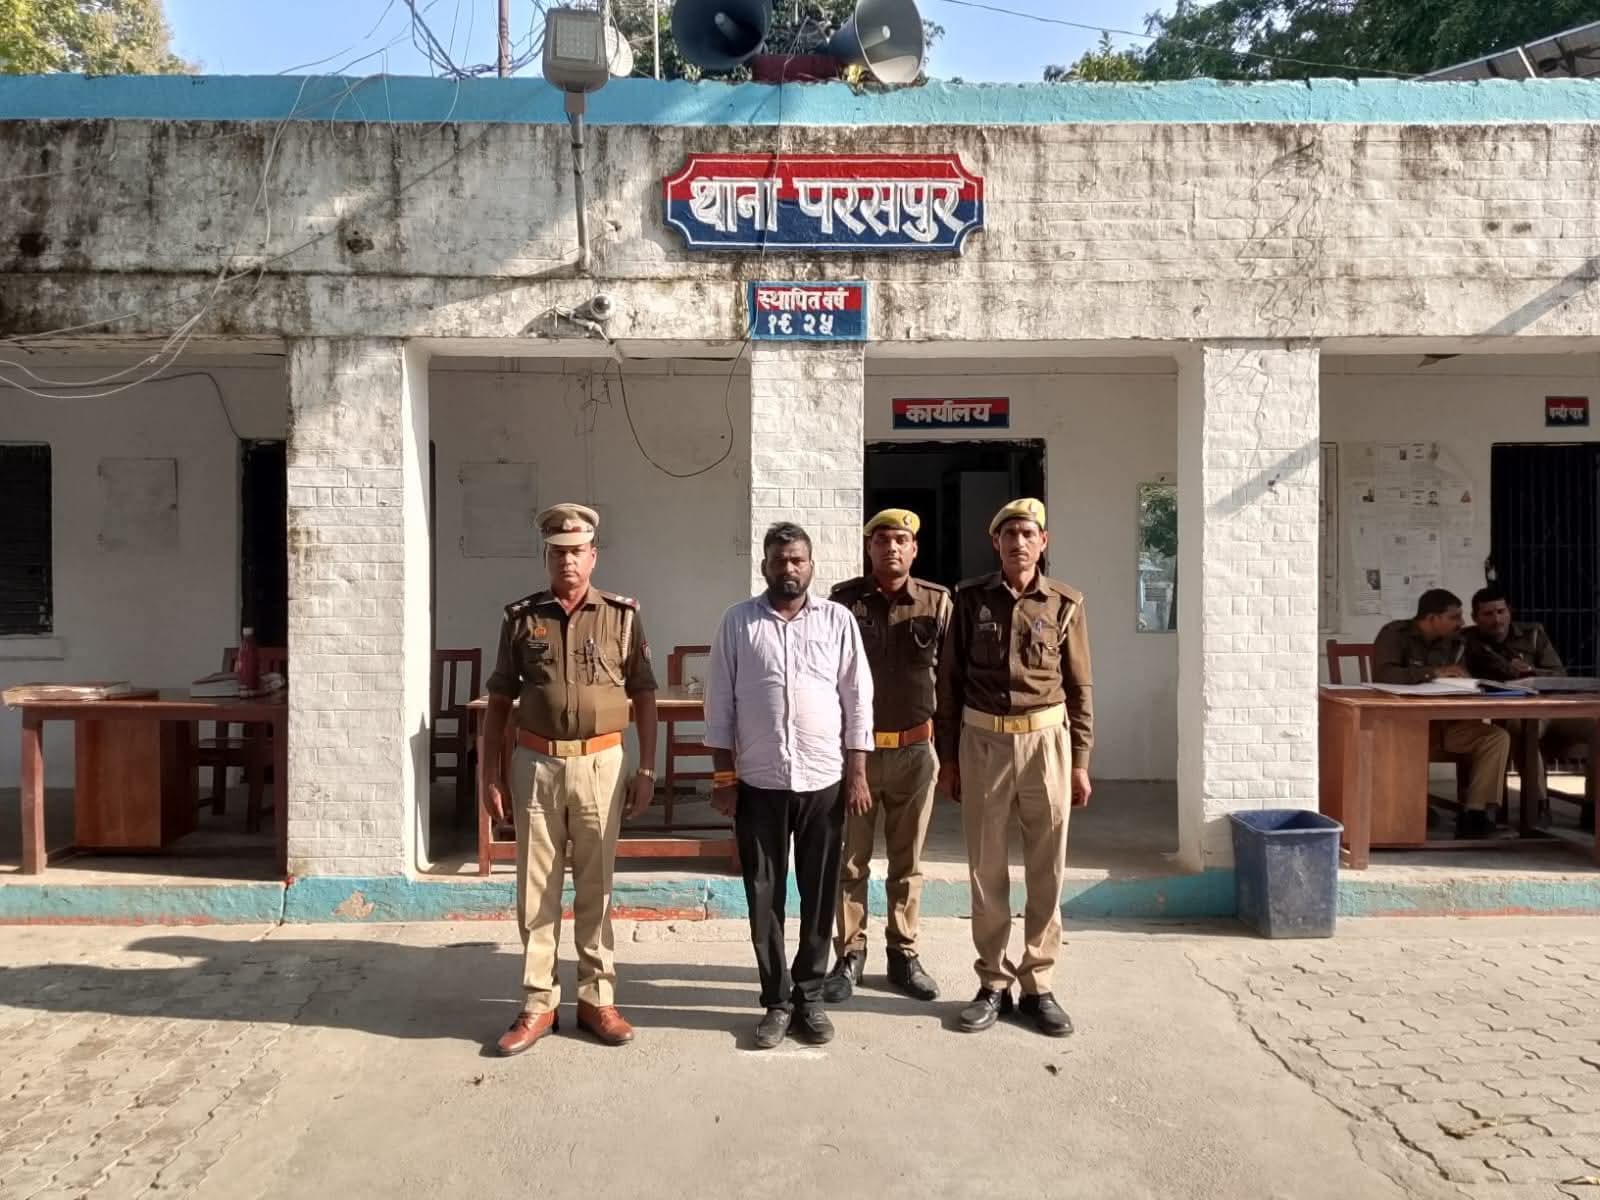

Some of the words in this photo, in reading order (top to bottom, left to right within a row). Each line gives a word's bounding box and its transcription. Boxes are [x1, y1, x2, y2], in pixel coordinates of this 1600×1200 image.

[690, 177, 782, 232] थाना
[793, 177, 964, 242] परसपुर
[758, 288, 821, 311] स्थापित
[906, 400, 992, 422] कार्यालय
